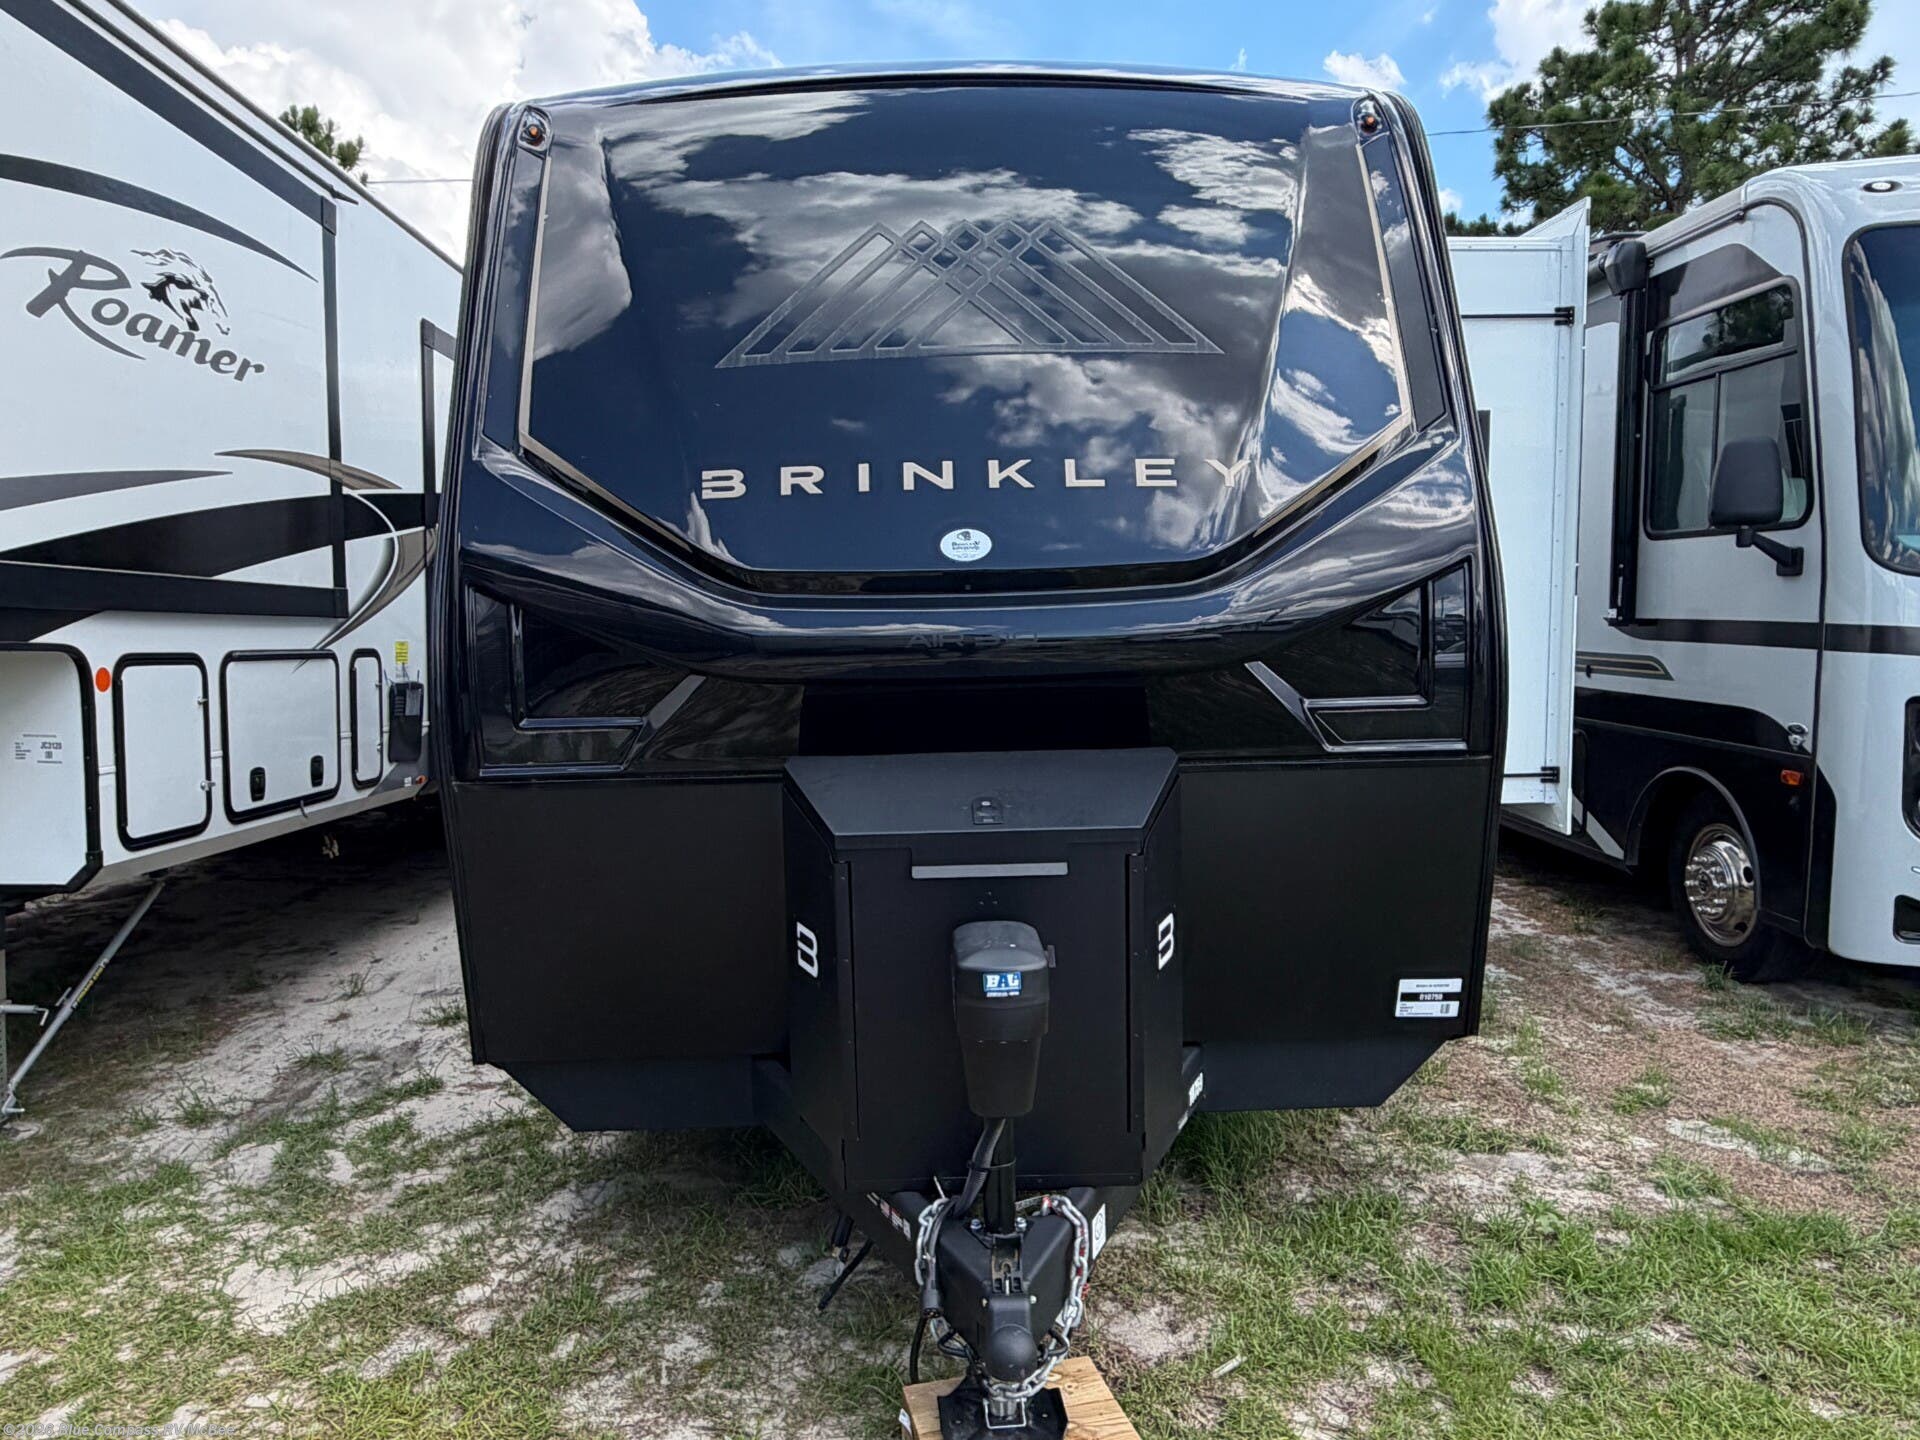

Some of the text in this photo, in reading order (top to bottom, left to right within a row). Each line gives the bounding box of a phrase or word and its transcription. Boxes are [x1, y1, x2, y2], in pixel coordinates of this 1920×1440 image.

[0, 247, 265, 382] Roamer
[701, 459, 1252, 499] BRINKLEY
[906, 632, 964, 648] AIR
